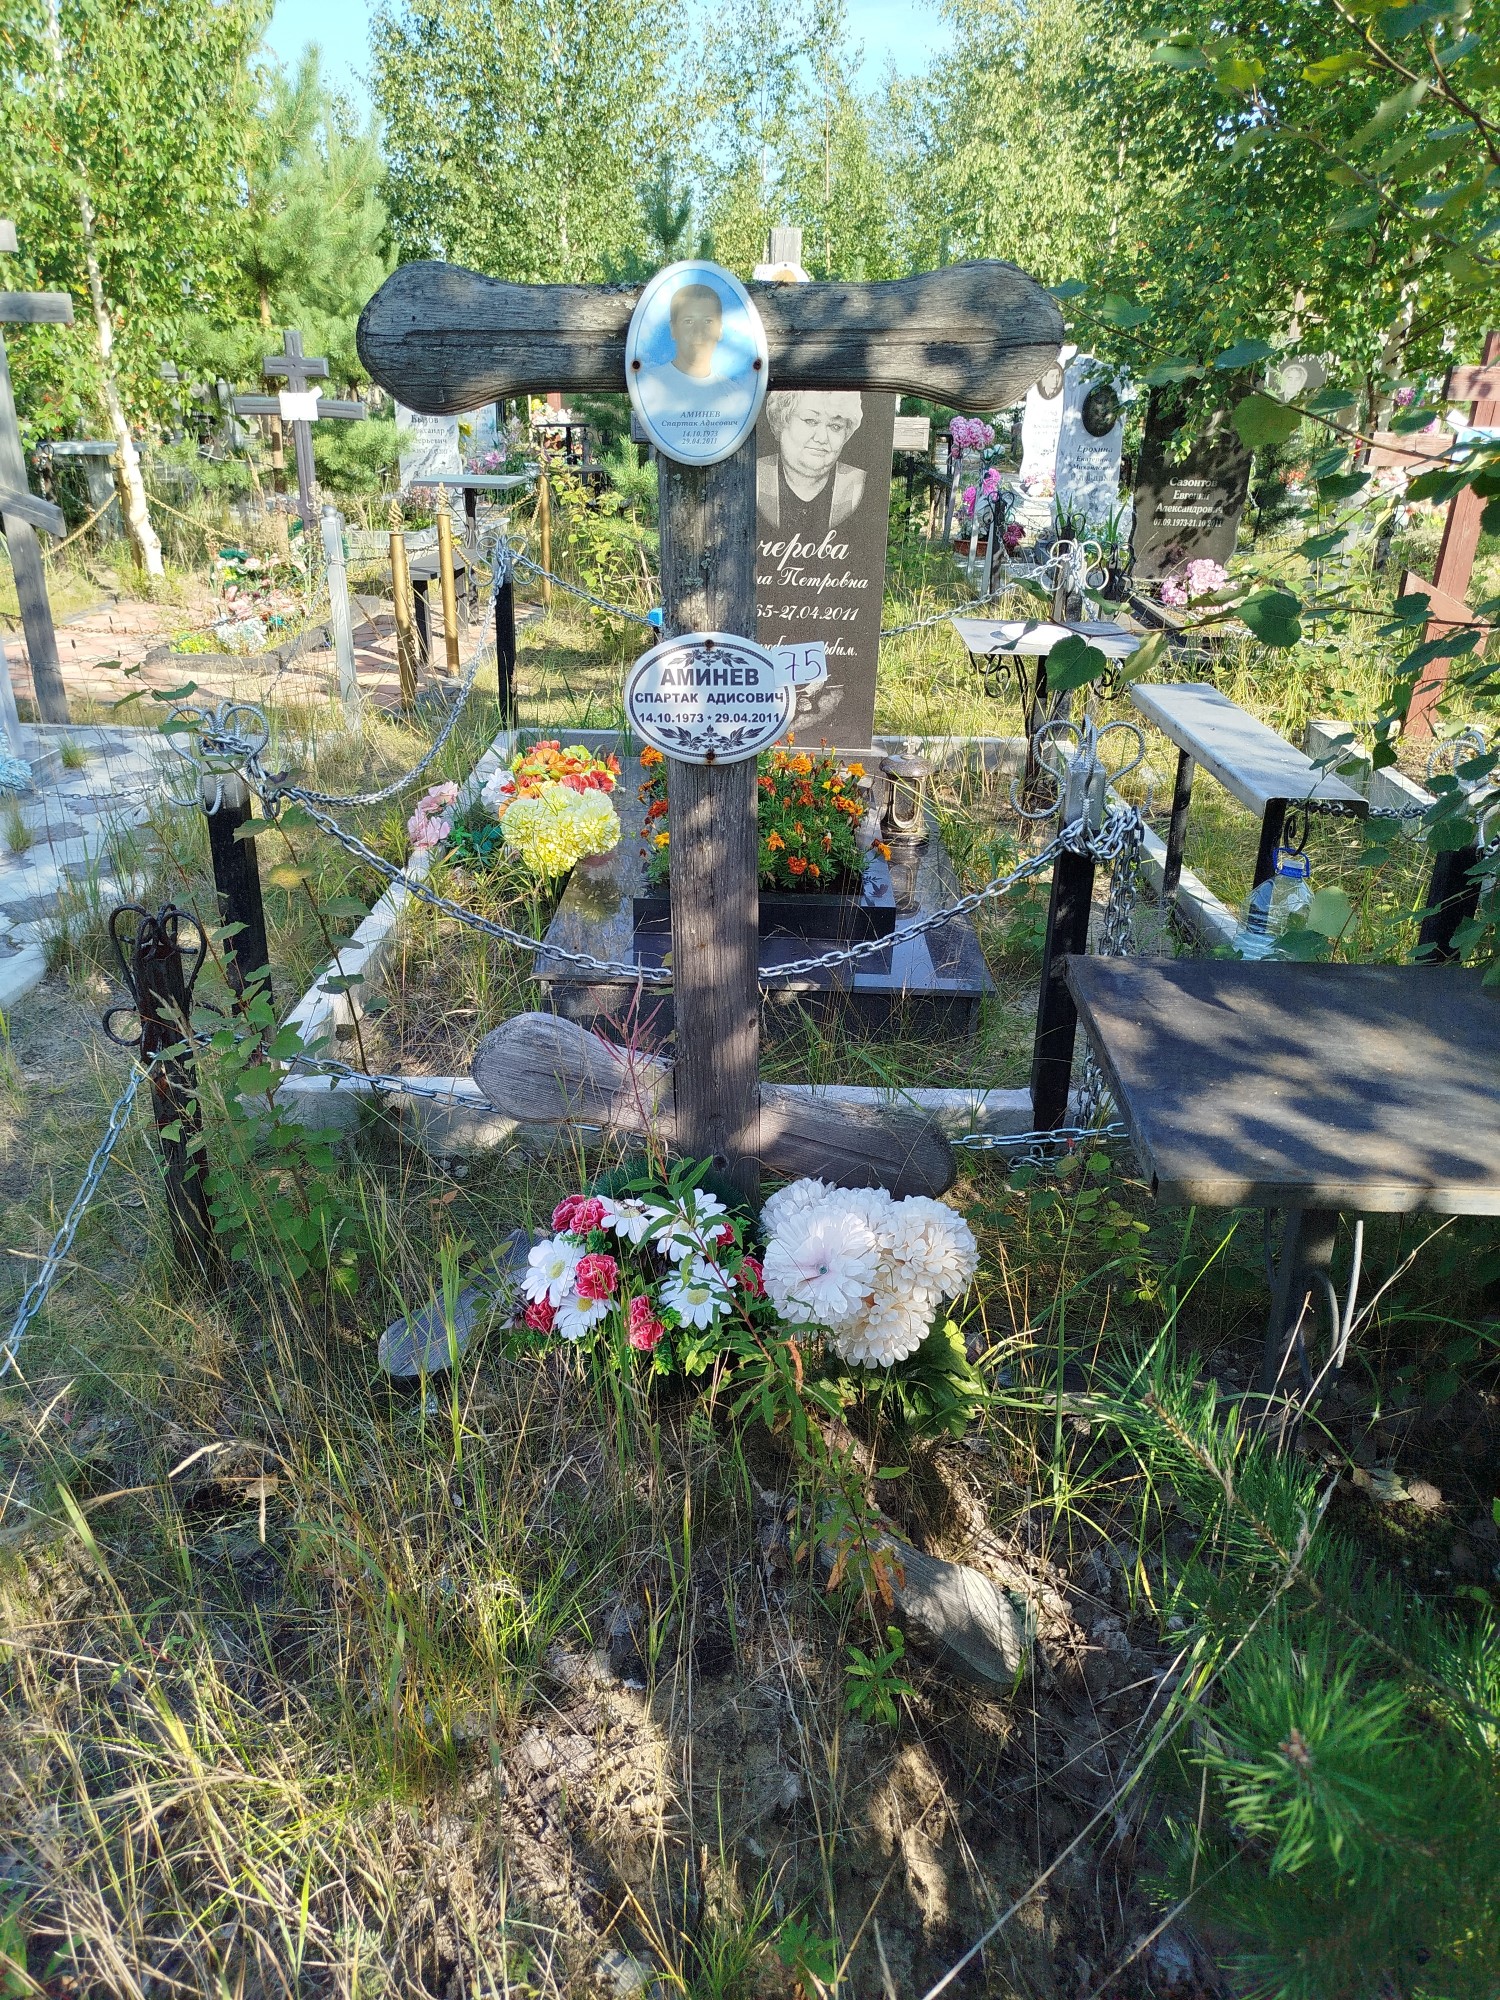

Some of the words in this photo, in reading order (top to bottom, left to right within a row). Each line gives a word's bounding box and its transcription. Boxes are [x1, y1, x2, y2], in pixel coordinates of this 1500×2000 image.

[661, 420, 698, 428] Спартак
[1077, 445, 1113, 454] Ерохина
[1169, 476, 1218, 487] Сазонтов
[1173, 489, 1211, 501] Евгений
[1155, 502, 1223, 515] Александрович
[756, 529, 850, 571] черова
[777, 566, 869, 595] Петровна
[756, 603, 860, 621] 65-27.04.2011
[778, 650, 822, 682] 75
[660, 668, 759, 686] АМИНЕВ
[635, 692, 699, 703] СПАРТАК
[706, 692, 784, 705] АДИСОВИЧ
[639, 713, 705, 723] 14.10.1973
[715, 713, 781, 723] 29.04.2011
